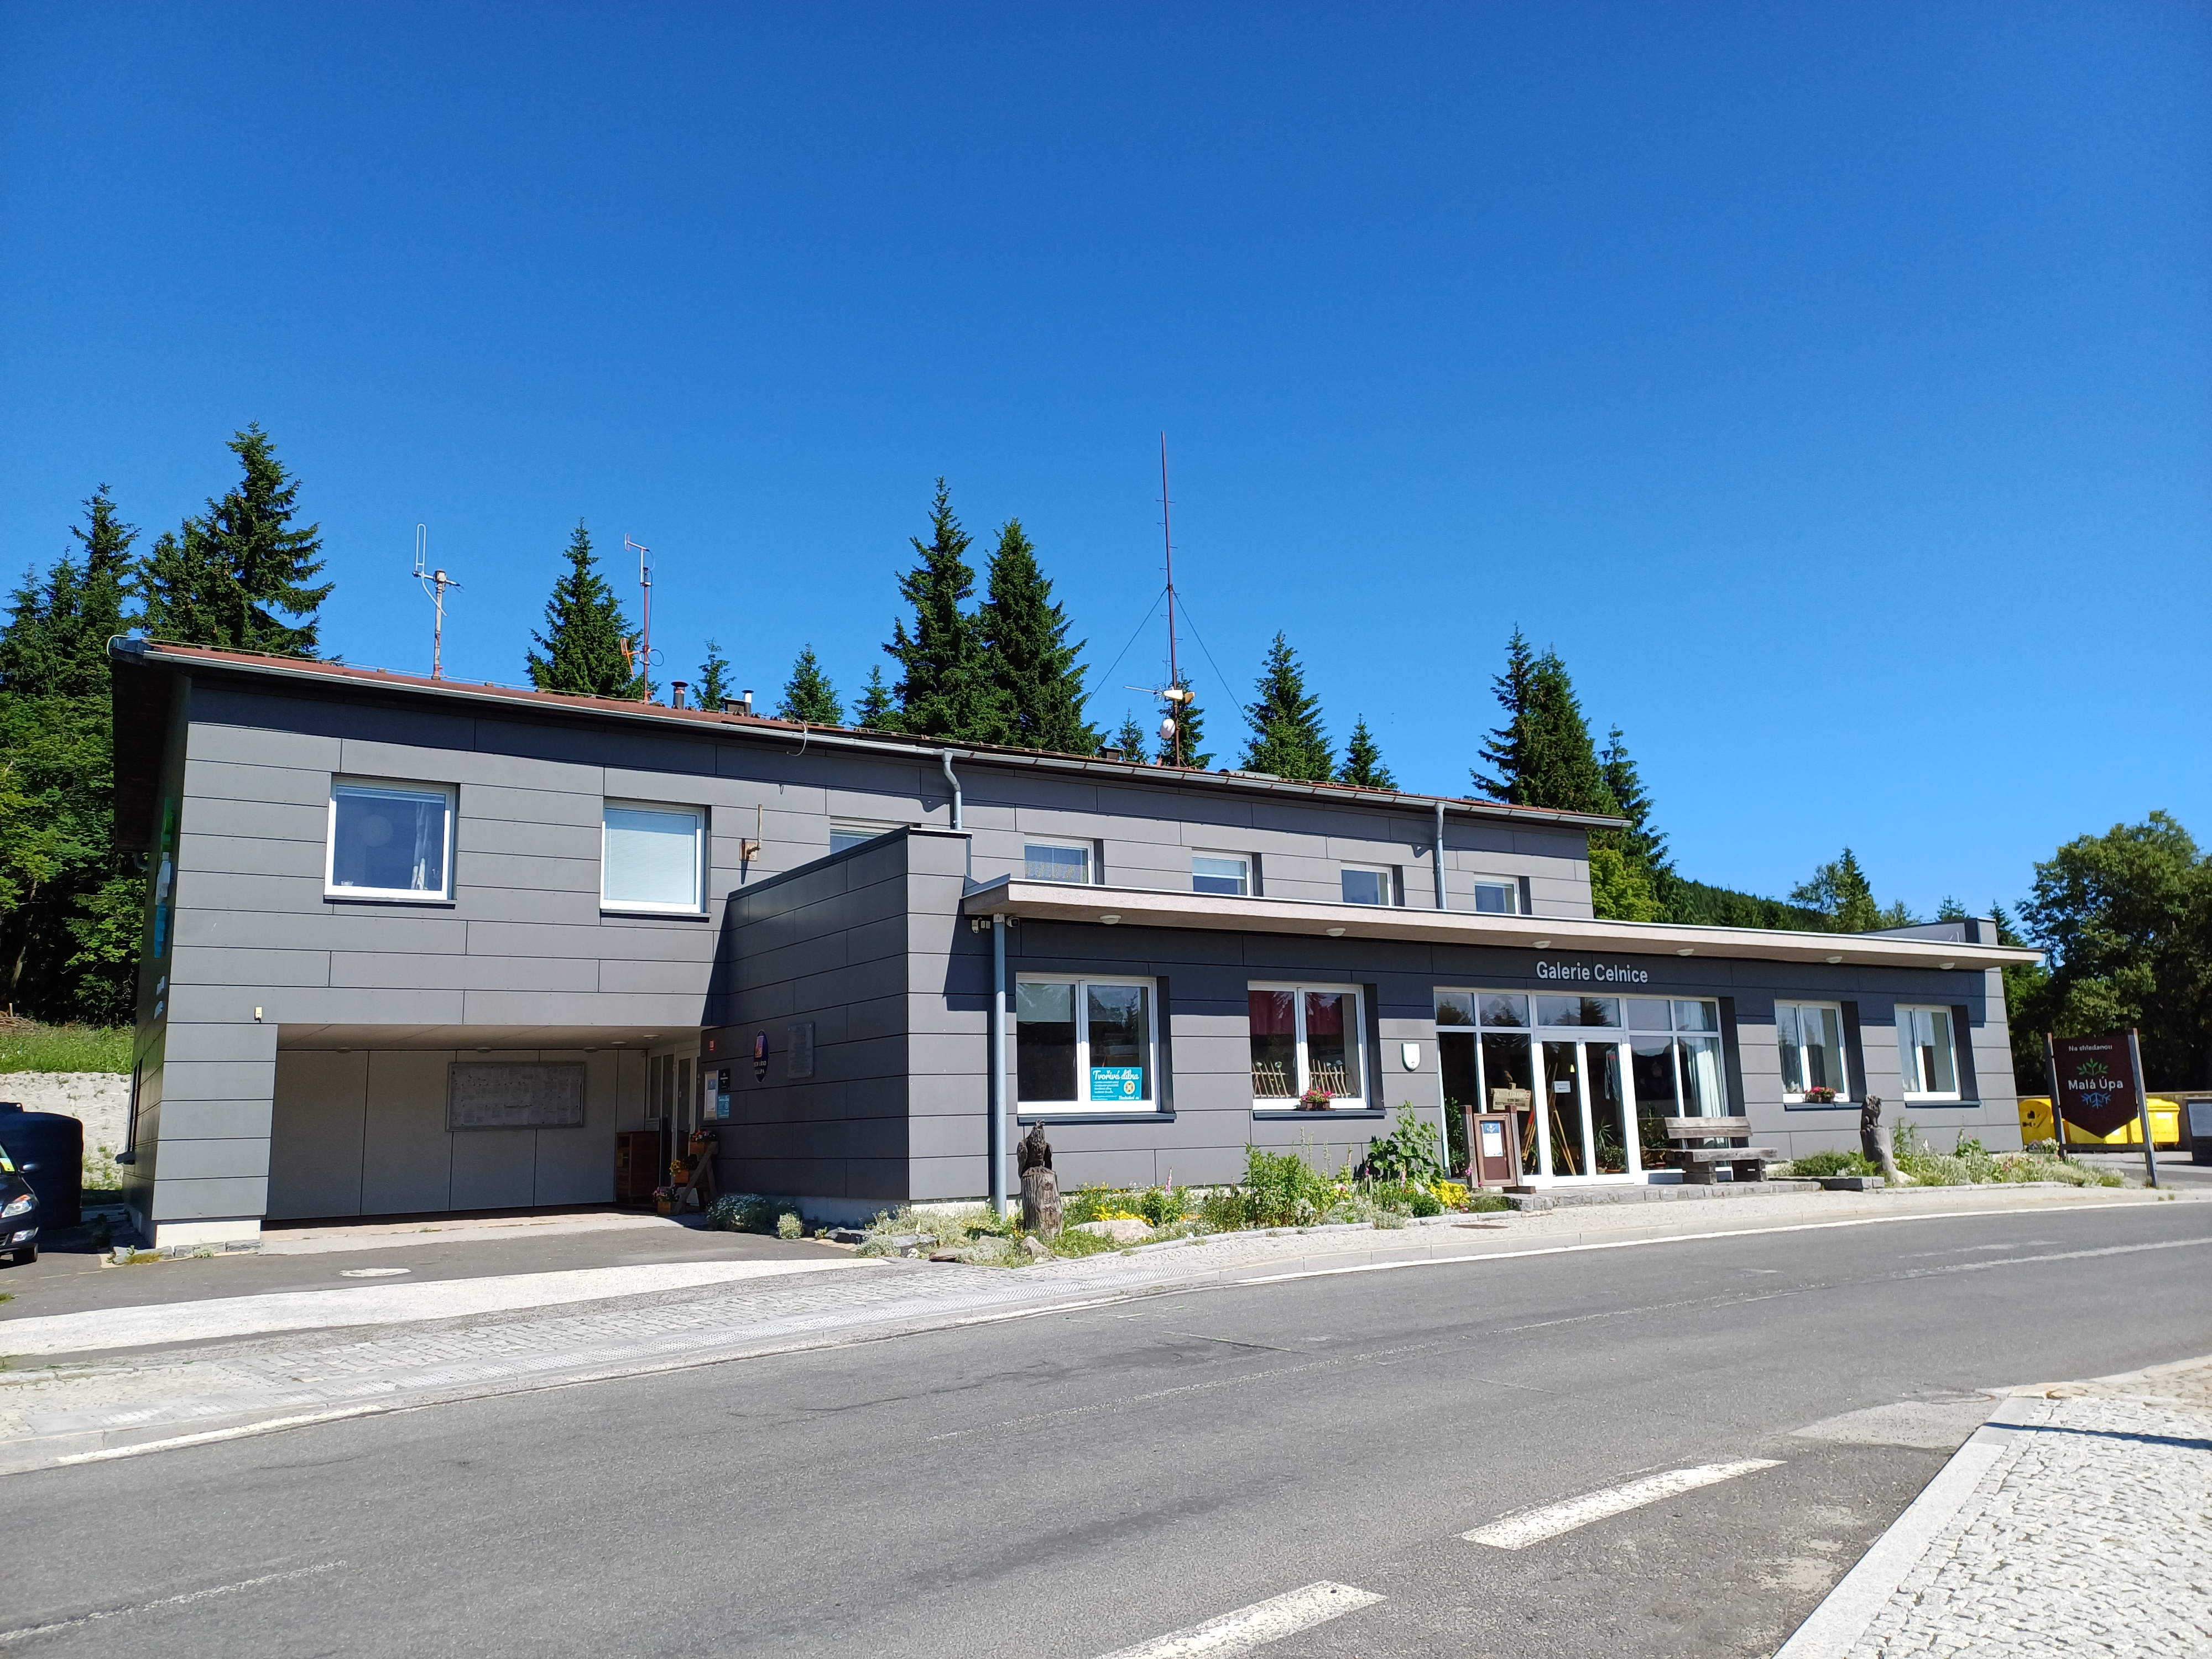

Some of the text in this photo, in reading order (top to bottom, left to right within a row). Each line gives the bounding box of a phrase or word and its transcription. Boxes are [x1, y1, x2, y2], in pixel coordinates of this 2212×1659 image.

[1536, 961, 1648, 983] Galerie Celnice
[2068, 1076, 2124, 1092] Malá Úpa
